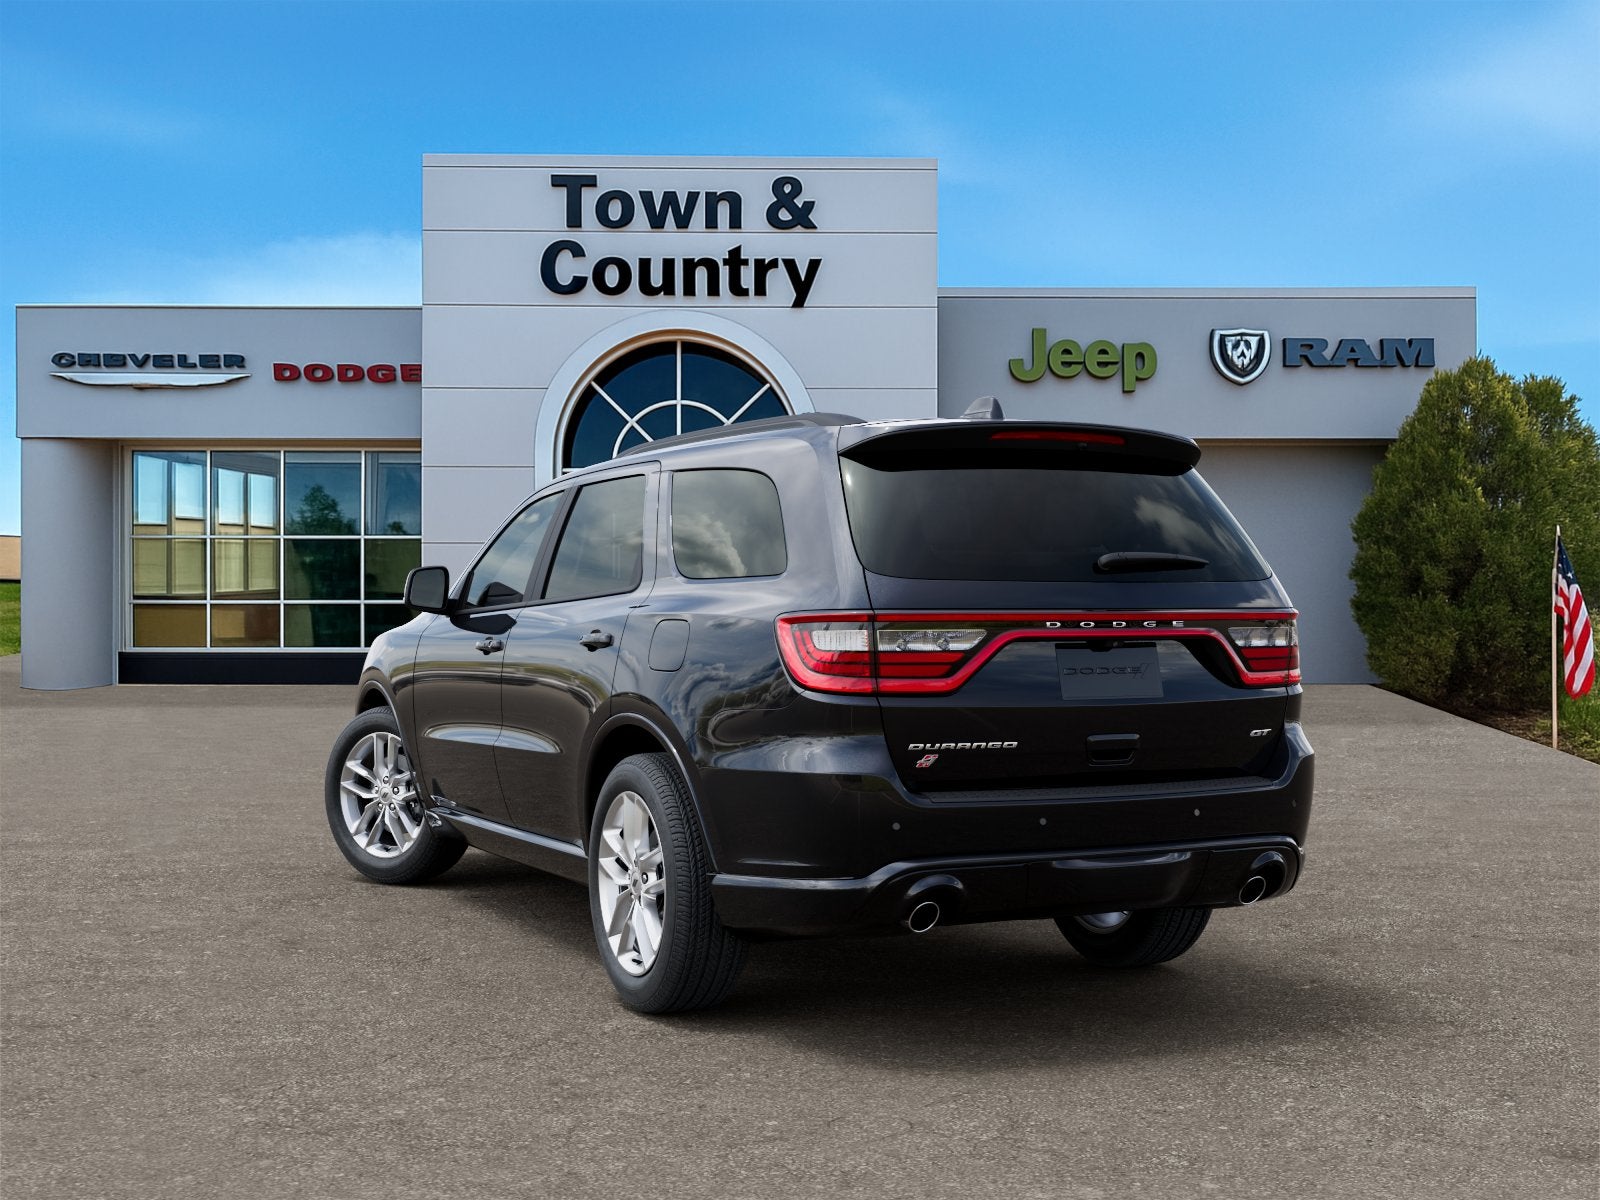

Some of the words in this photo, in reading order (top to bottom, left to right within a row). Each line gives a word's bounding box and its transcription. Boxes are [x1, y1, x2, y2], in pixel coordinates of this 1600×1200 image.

[551, 174, 742, 229] Town
[765, 176, 818, 230] &
[540, 239, 822, 308] Country
[1008, 328, 1158, 393] Jeep
[1283, 337, 1435, 368] RAM
[272, 363, 422, 383] DODGE
[1046, 620, 1185, 628] DODGE
[1063, 666, 1142, 676] DODGE
[1250, 728, 1272, 737] GT
[908, 741, 1018, 751] DURANGO
